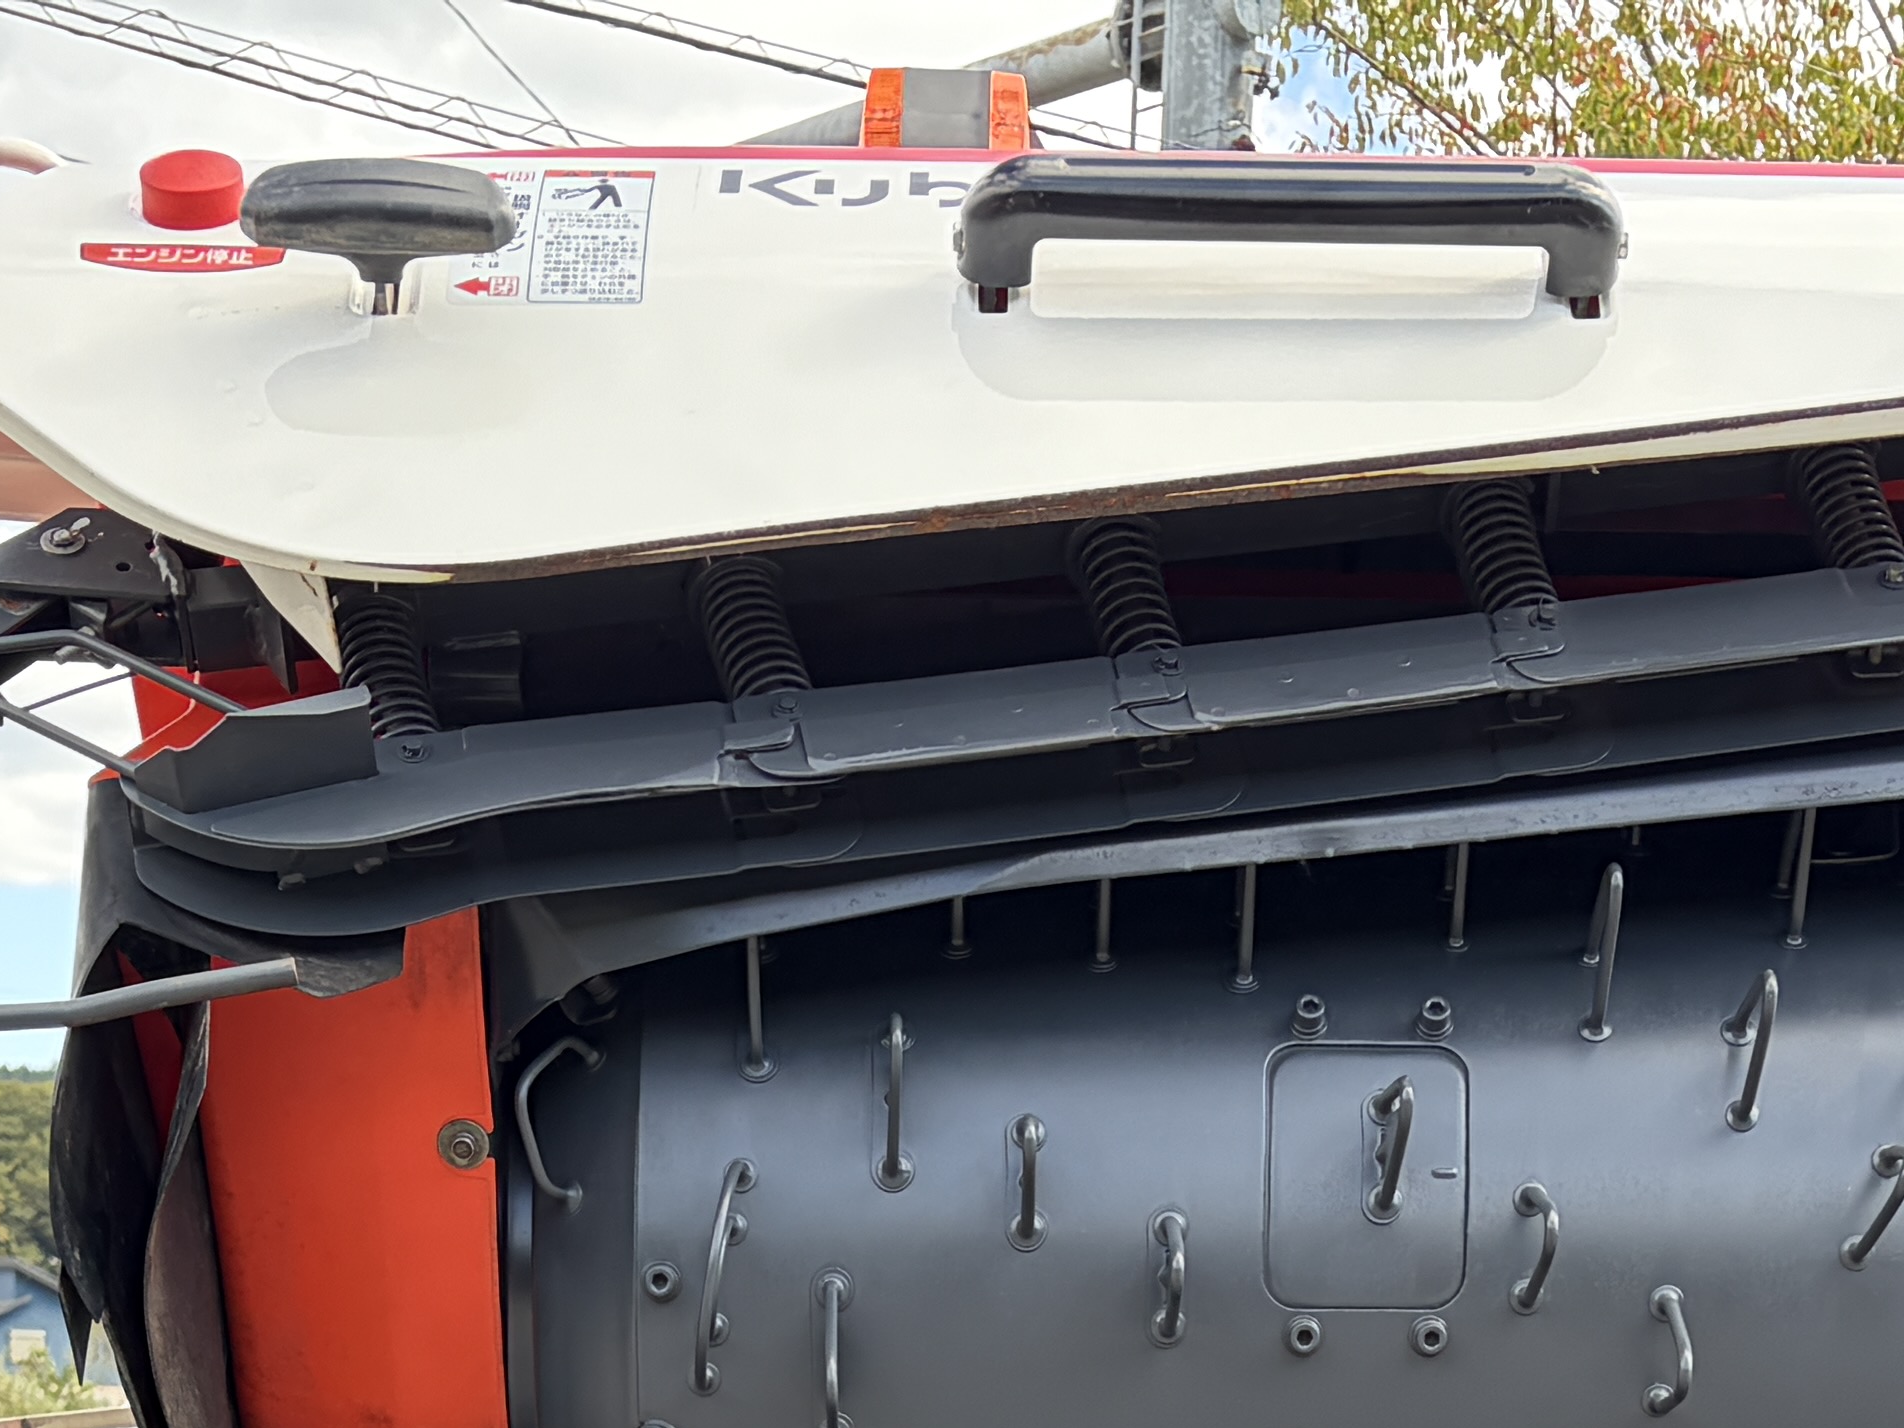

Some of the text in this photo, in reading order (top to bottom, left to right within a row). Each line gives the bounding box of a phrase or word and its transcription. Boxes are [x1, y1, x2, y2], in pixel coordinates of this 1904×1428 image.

[719, 169, 971, 207] Kub
[107, 247, 254, 265] エンジン停止
